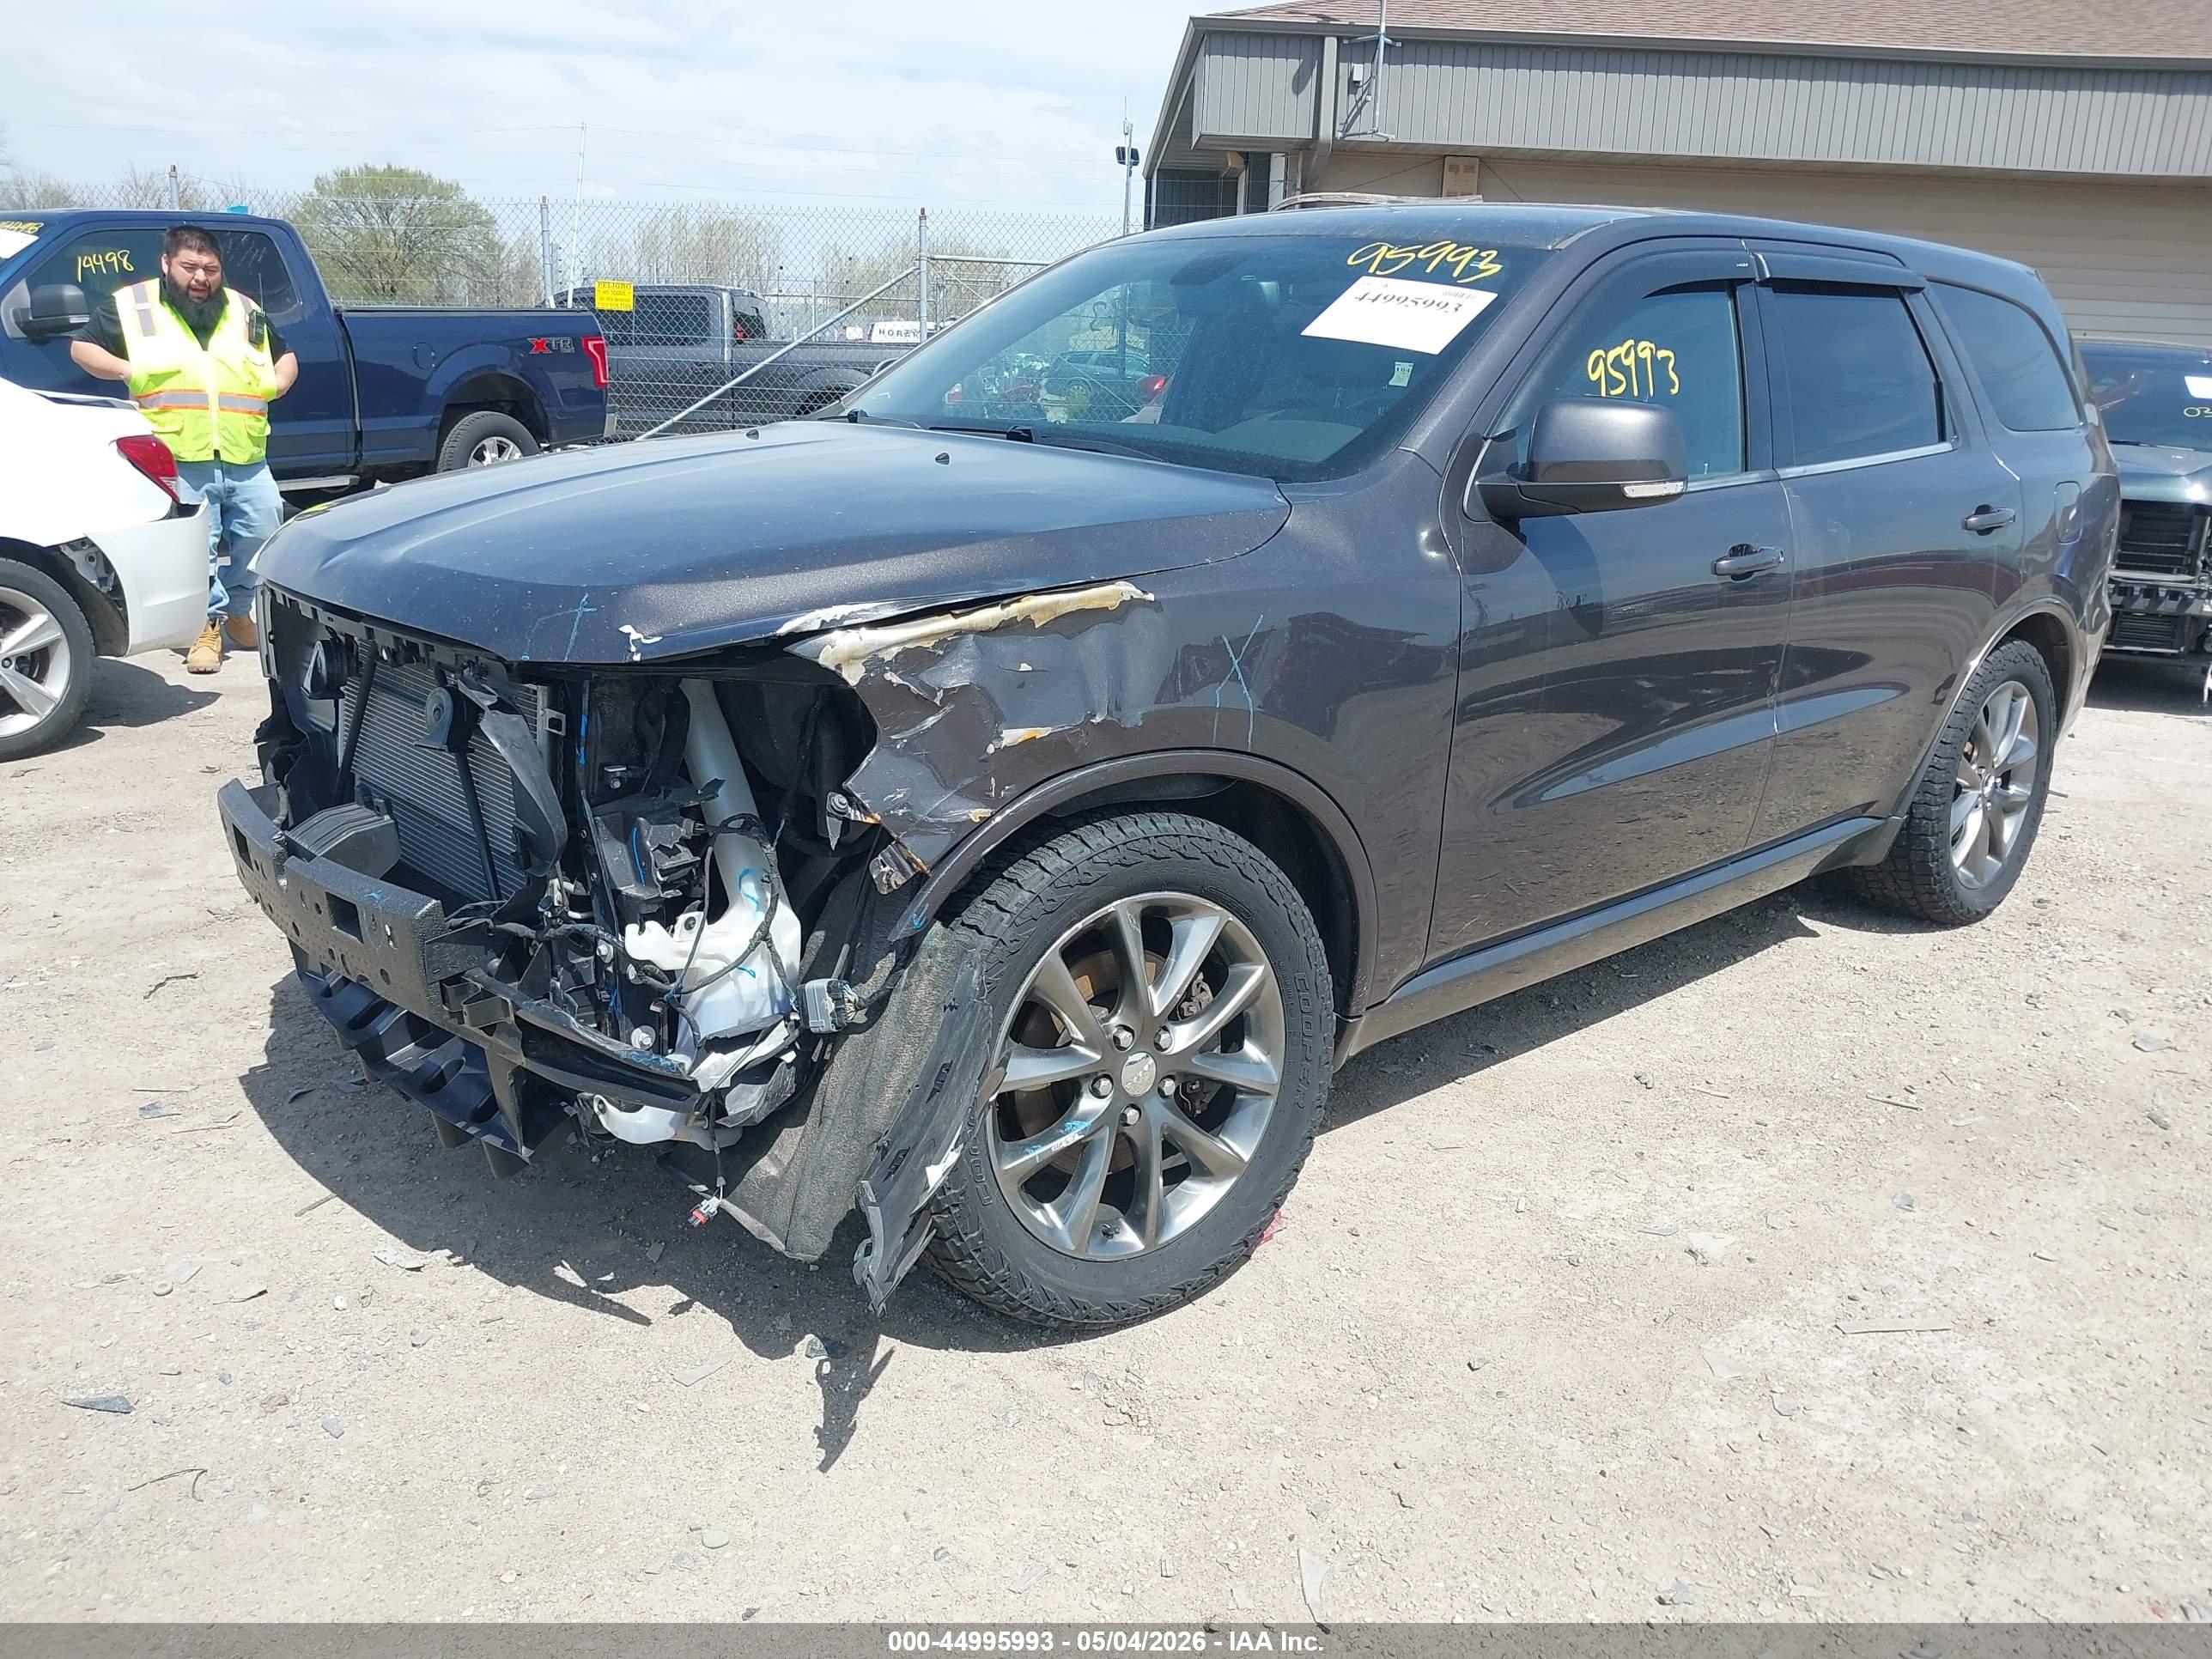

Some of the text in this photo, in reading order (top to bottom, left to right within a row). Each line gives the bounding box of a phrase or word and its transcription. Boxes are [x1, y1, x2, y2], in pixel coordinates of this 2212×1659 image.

[1346, 240, 1504, 283] 95993
[1354, 291, 1463, 314] 44995993
[527, 337, 574, 354] XTR
[1587, 338, 1680, 398] 95993
[1294, 971, 1314, 1110] COOPER
